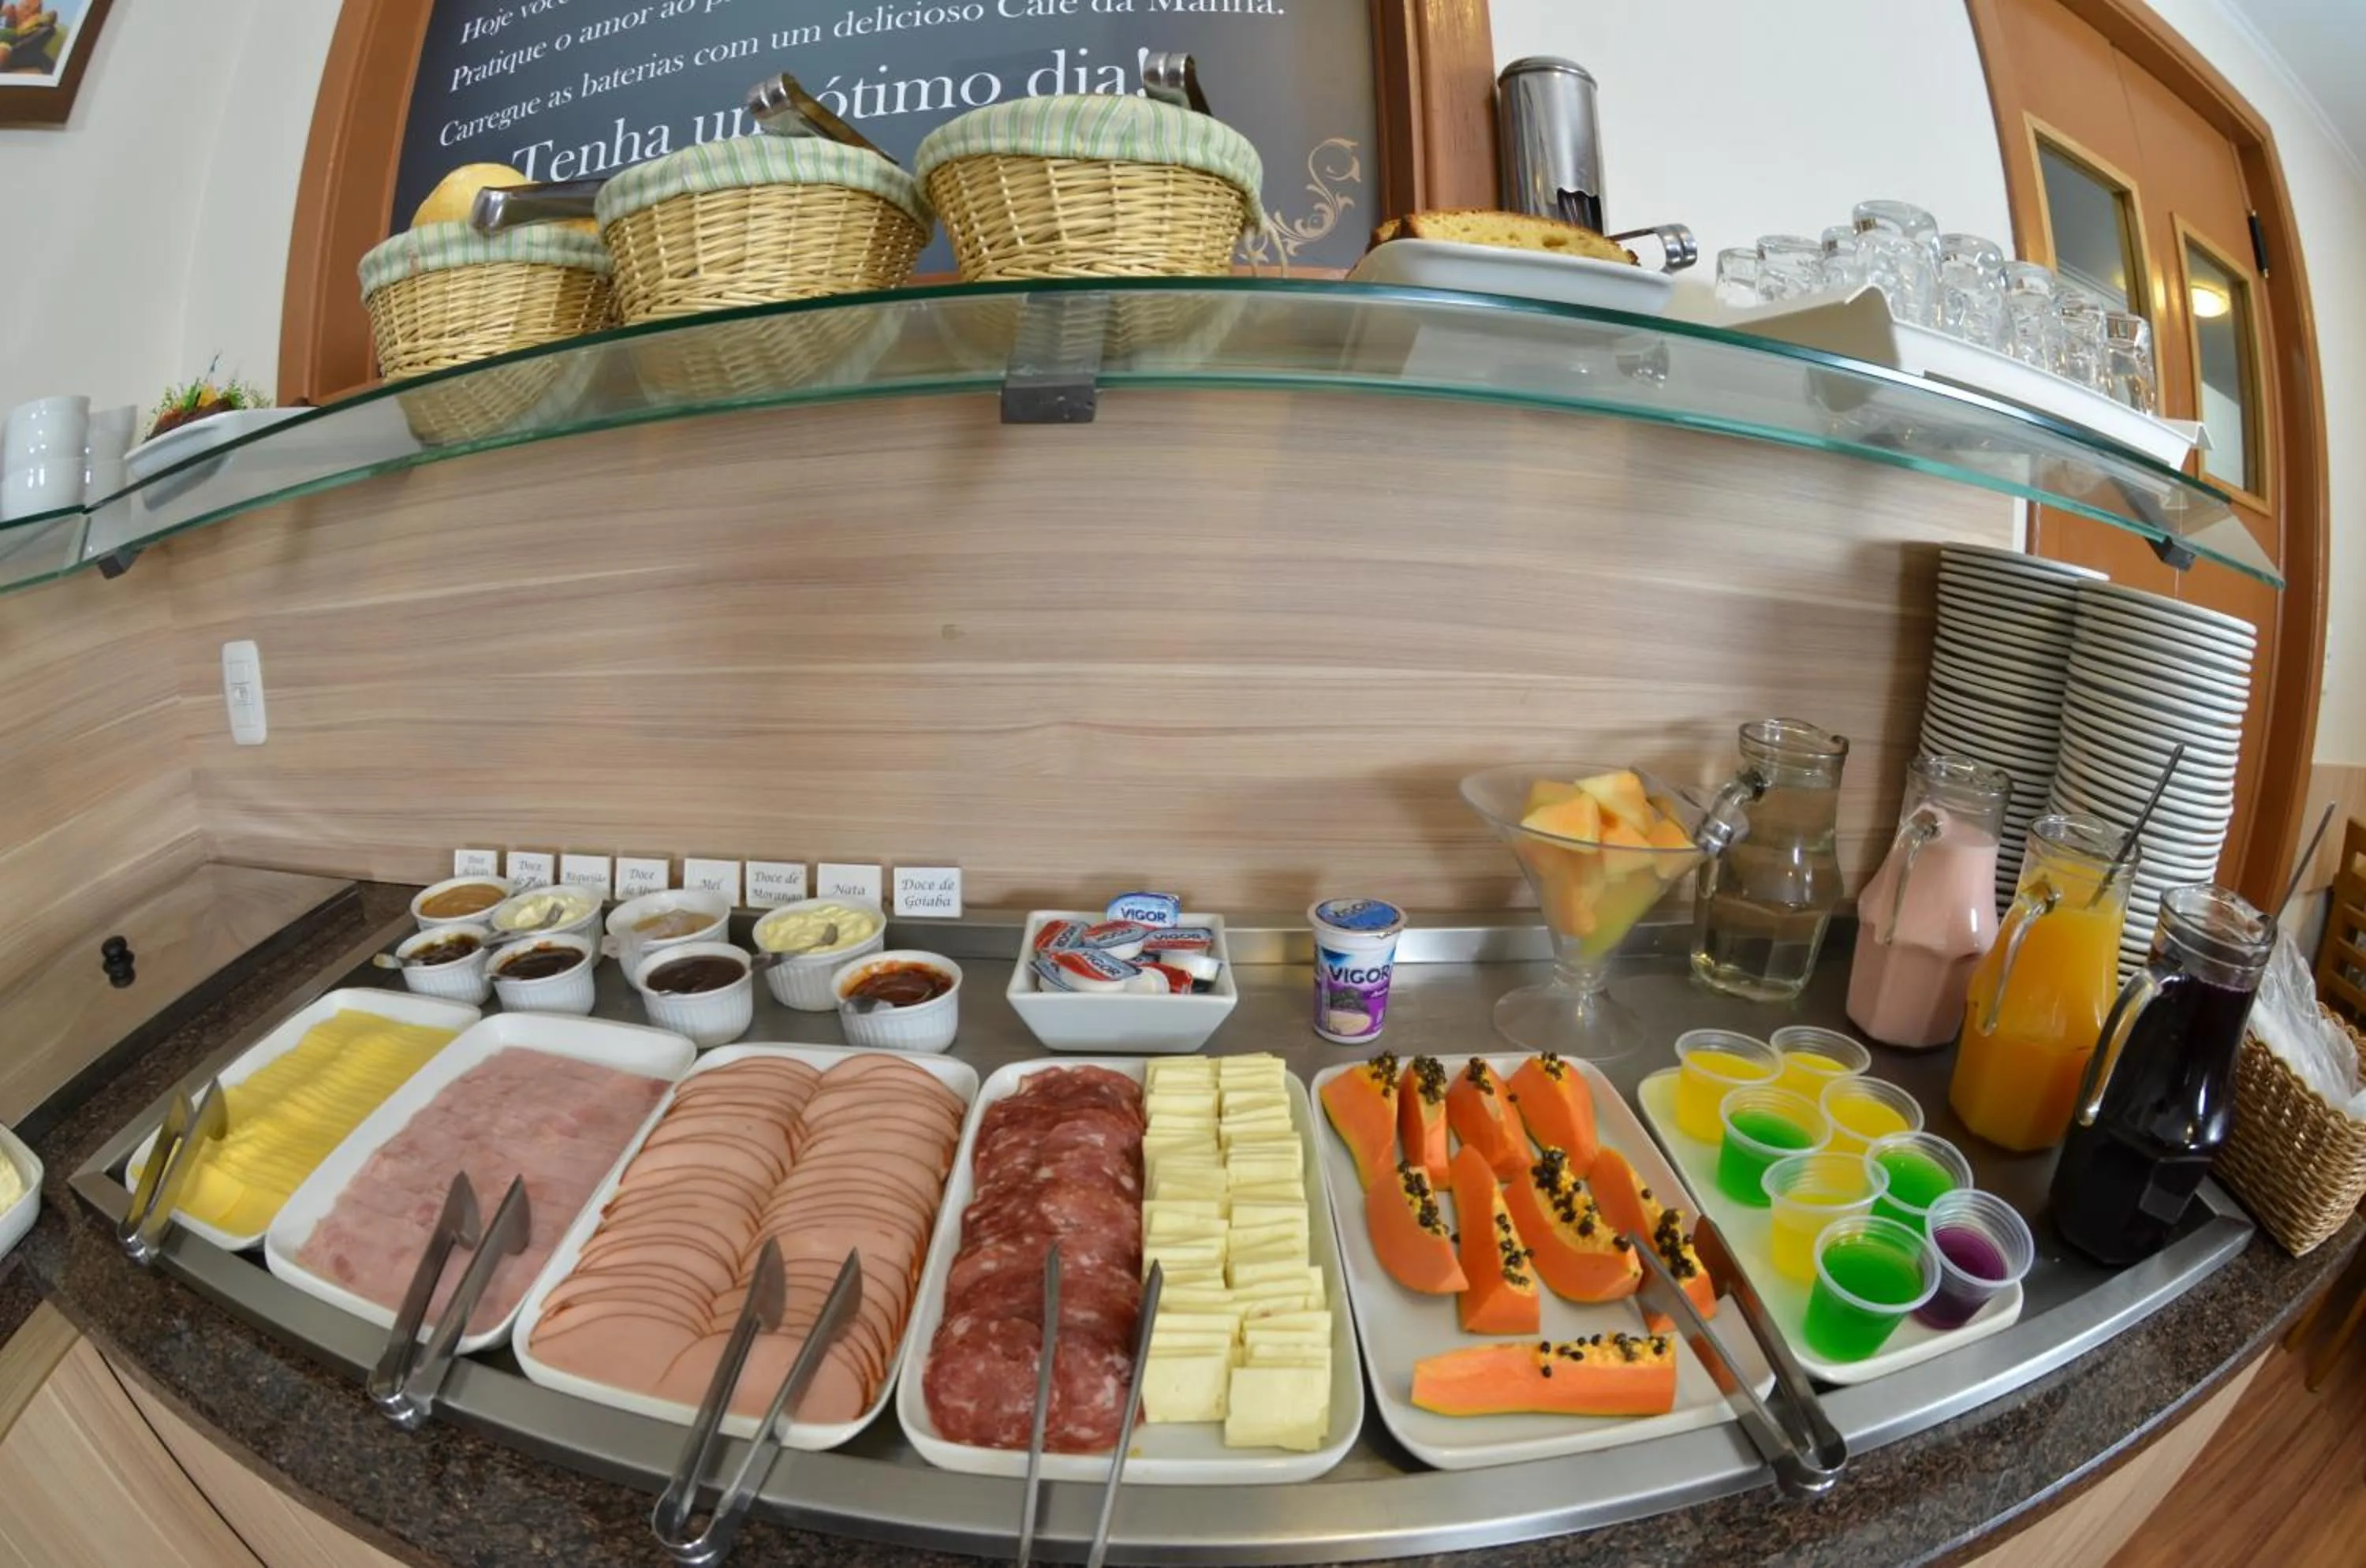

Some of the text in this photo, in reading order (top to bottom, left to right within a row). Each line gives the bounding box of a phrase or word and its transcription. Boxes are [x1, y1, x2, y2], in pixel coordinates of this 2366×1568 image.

[460, 0, 569, 44] Hoje voc
[450, 41, 547, 93] Pratique
[554, 33, 572, 51] o
[579, 7, 654, 43] amor
[660, 0, 695, 19] ao
[439, 97, 541, 146] Carregue
[547, 86, 573, 108] as
[581, 53, 685, 98] baterias
[694, 37, 759, 66] com
[771, 24, 821, 50] um
[834, 1, 984, 38] delicioso
[511, 118, 674, 182] Tenha
[816, 65, 1002, 118] ótimo
[1027, 47, 1150, 98] dia!
[755, 871, 801, 884] Doce de
[901, 876, 955, 890] Doce de
[833, 883, 866, 895] Nata
[905, 894, 950, 908] Goiaba
[1121, 906, 1166, 923] VIGOR
[1082, 950, 1121, 976] VIGOR
[1328, 965, 1391, 984] VIGOR
